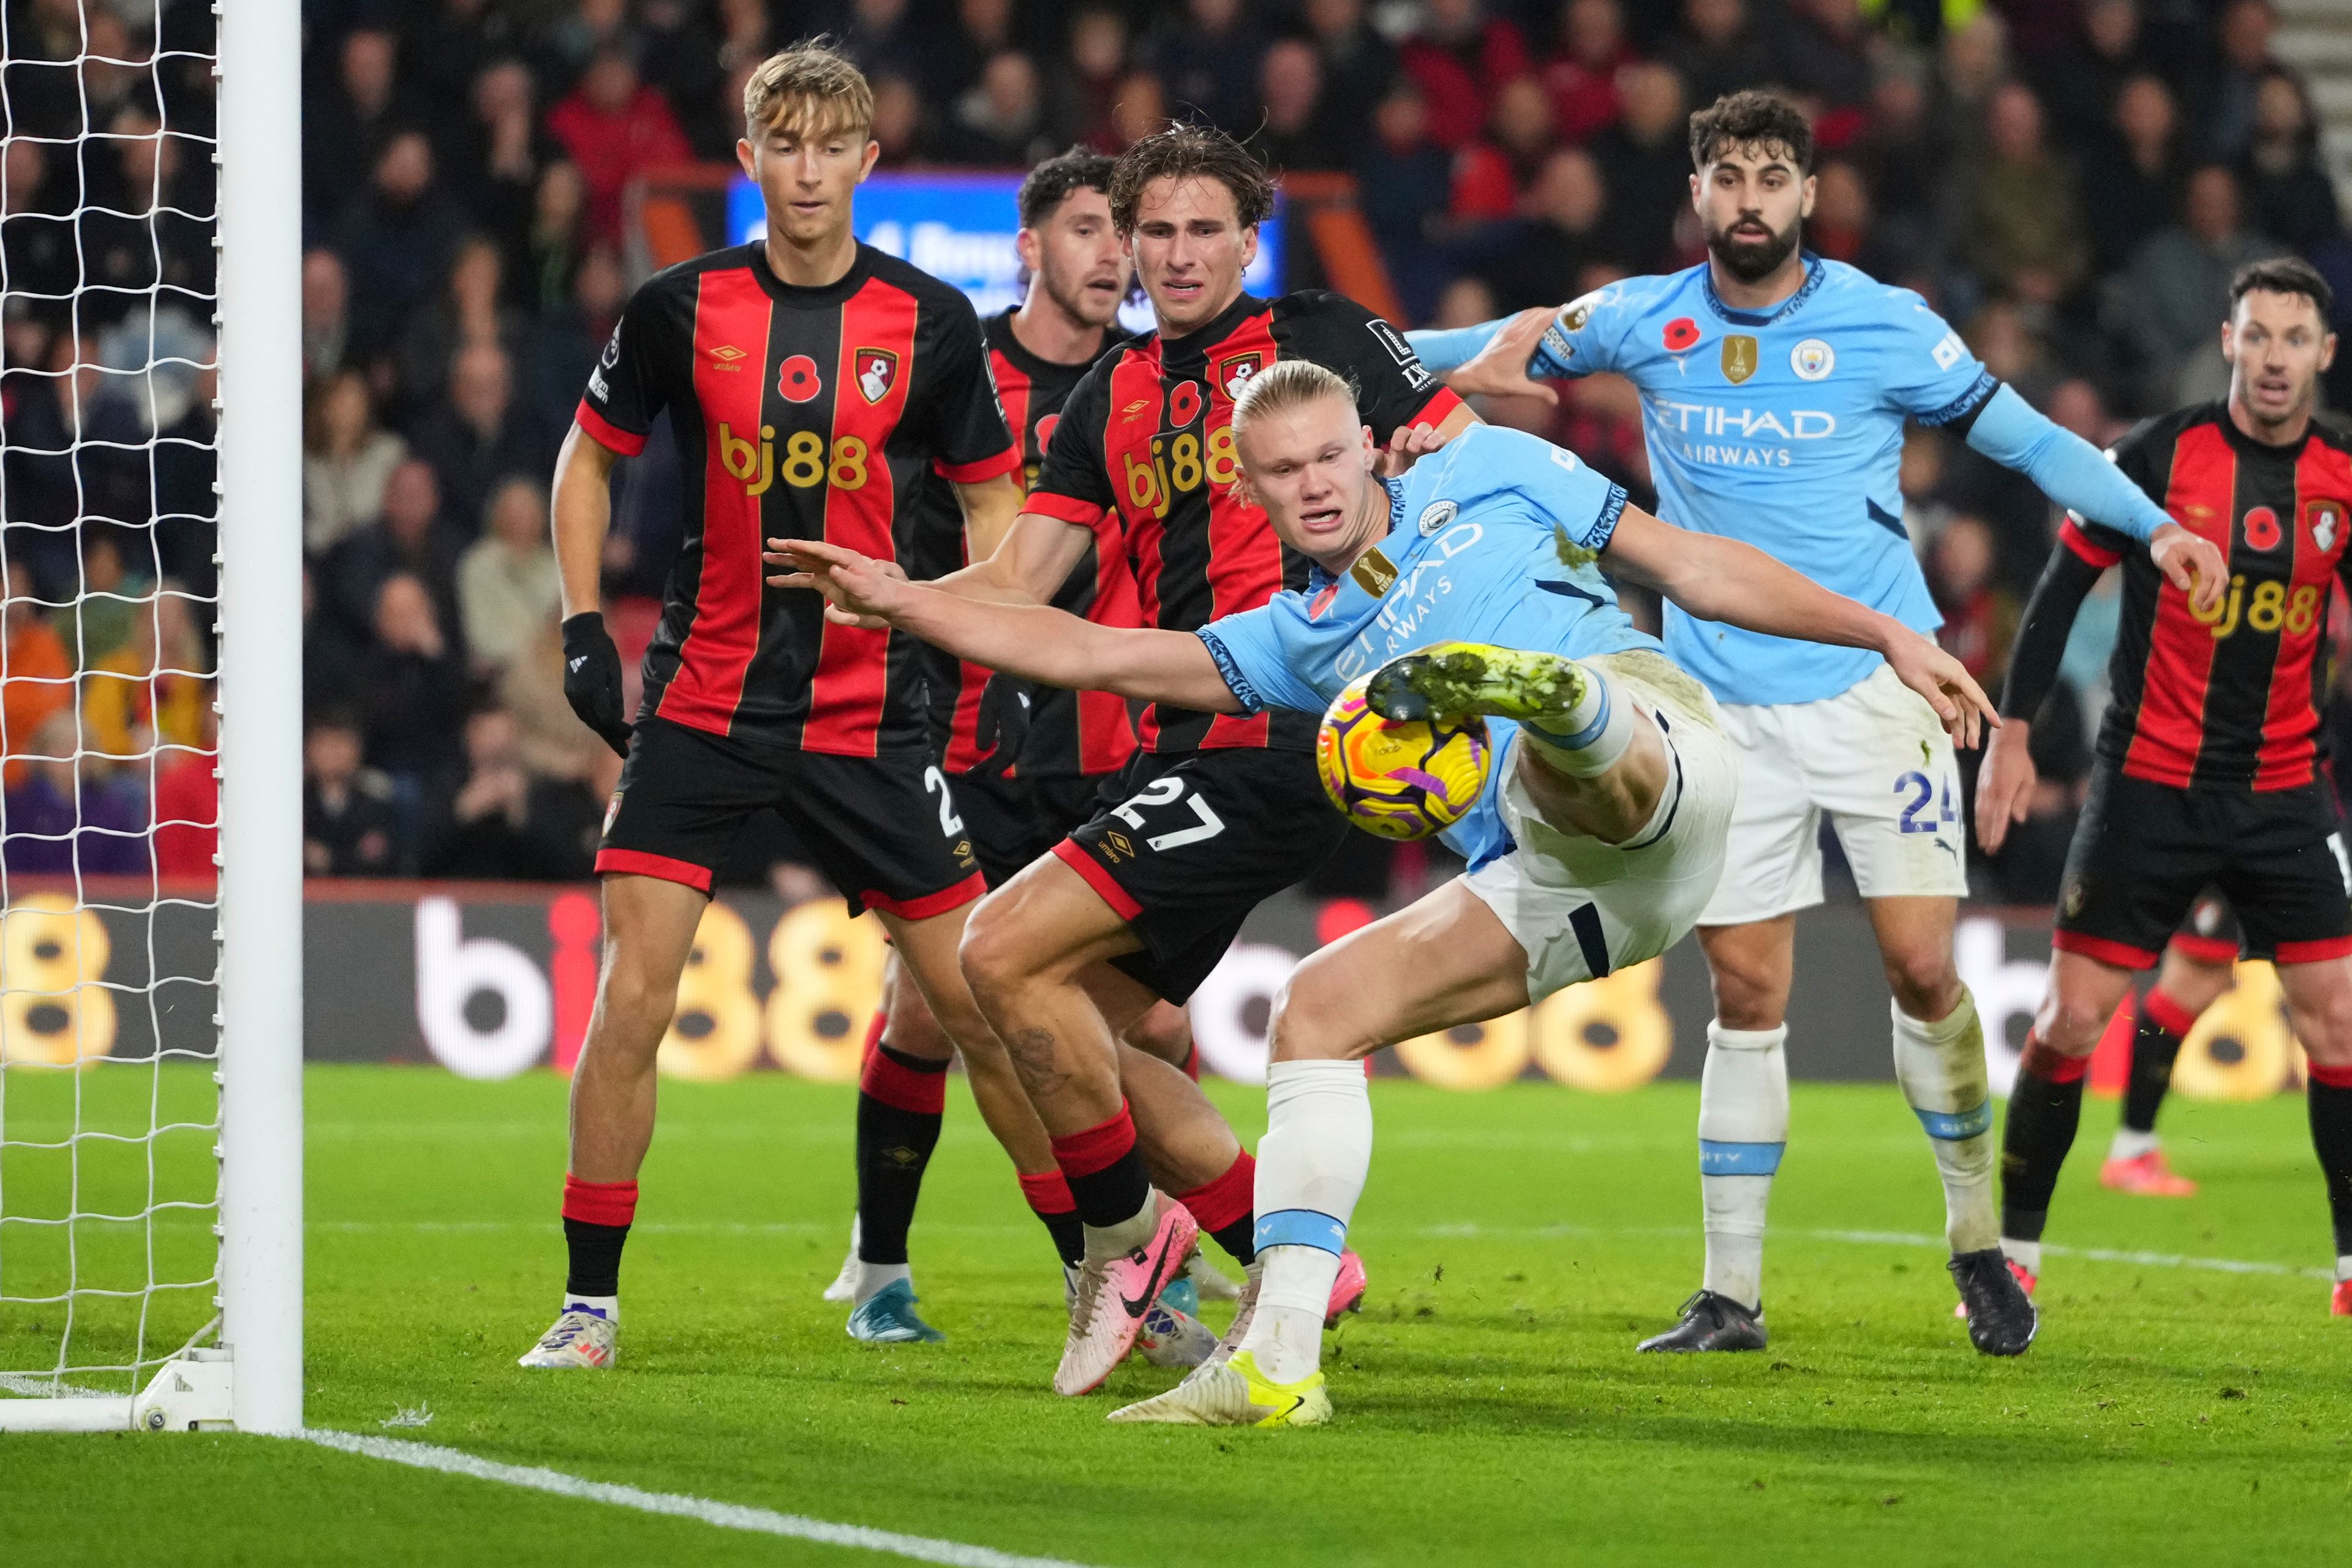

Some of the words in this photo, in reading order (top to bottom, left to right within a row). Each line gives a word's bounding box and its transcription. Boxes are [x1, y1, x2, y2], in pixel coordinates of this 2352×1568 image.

[1655, 400, 1835, 439] ETIHAD
[719, 423, 868, 496] bj88
[1683, 443, 1790, 466] AIRWAYS
[1124, 425, 1239, 518] bj88
[1421, 502, 1452, 529] MANCHESTE
[1378, 575, 1393, 592] FIFA
[1110, 777, 1225, 851] 27
[1098, 840, 1120, 863] umbro
